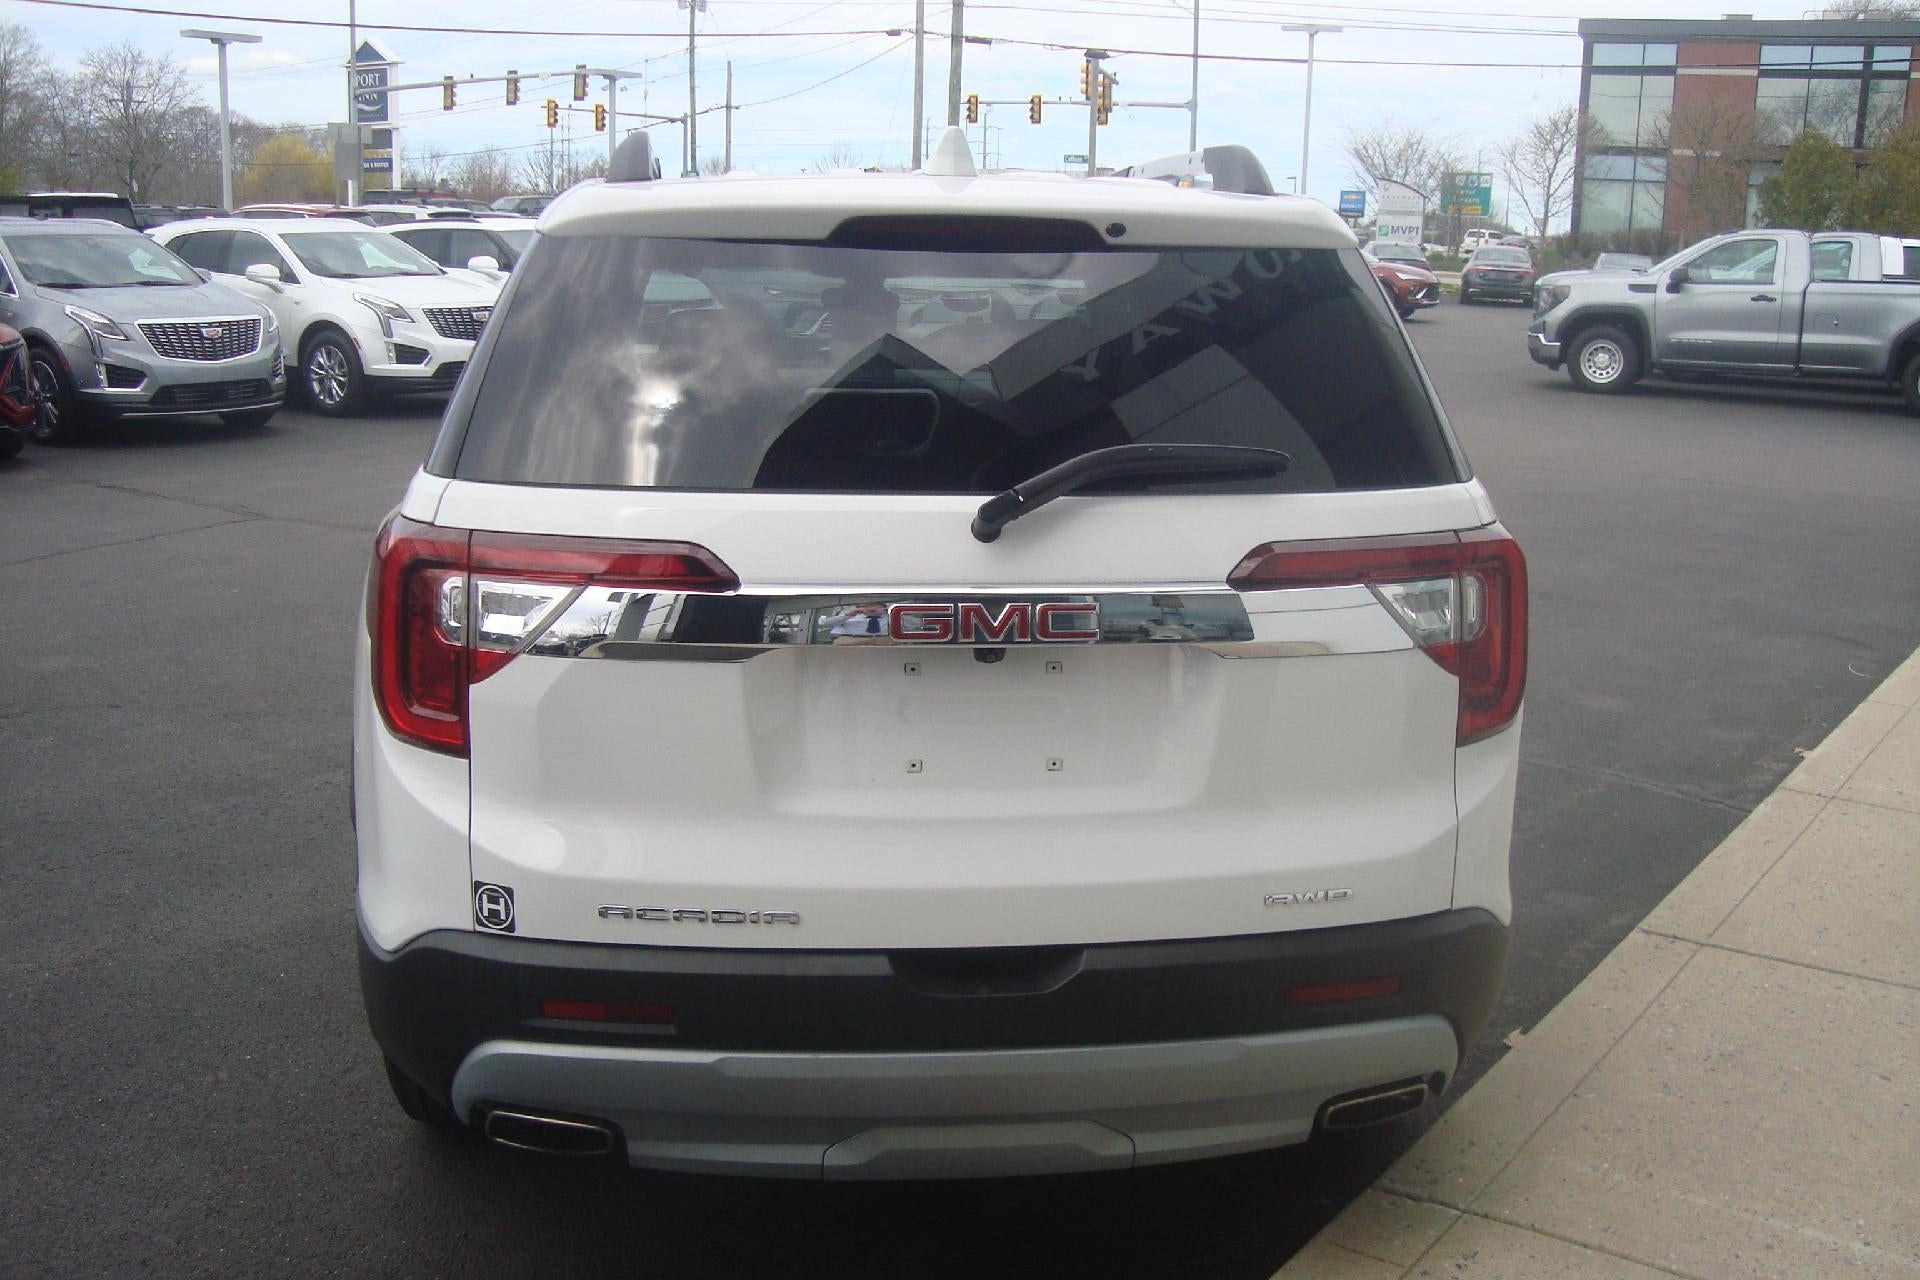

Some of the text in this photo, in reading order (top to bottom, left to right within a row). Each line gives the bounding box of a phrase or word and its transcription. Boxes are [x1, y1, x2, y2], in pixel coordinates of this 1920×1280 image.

[356, 73, 380, 87] PORT
[1391, 225, 1420, 236] MVPT
[888, 602, 1100, 643] GMC
[597, 903, 800, 925] ACADIA
